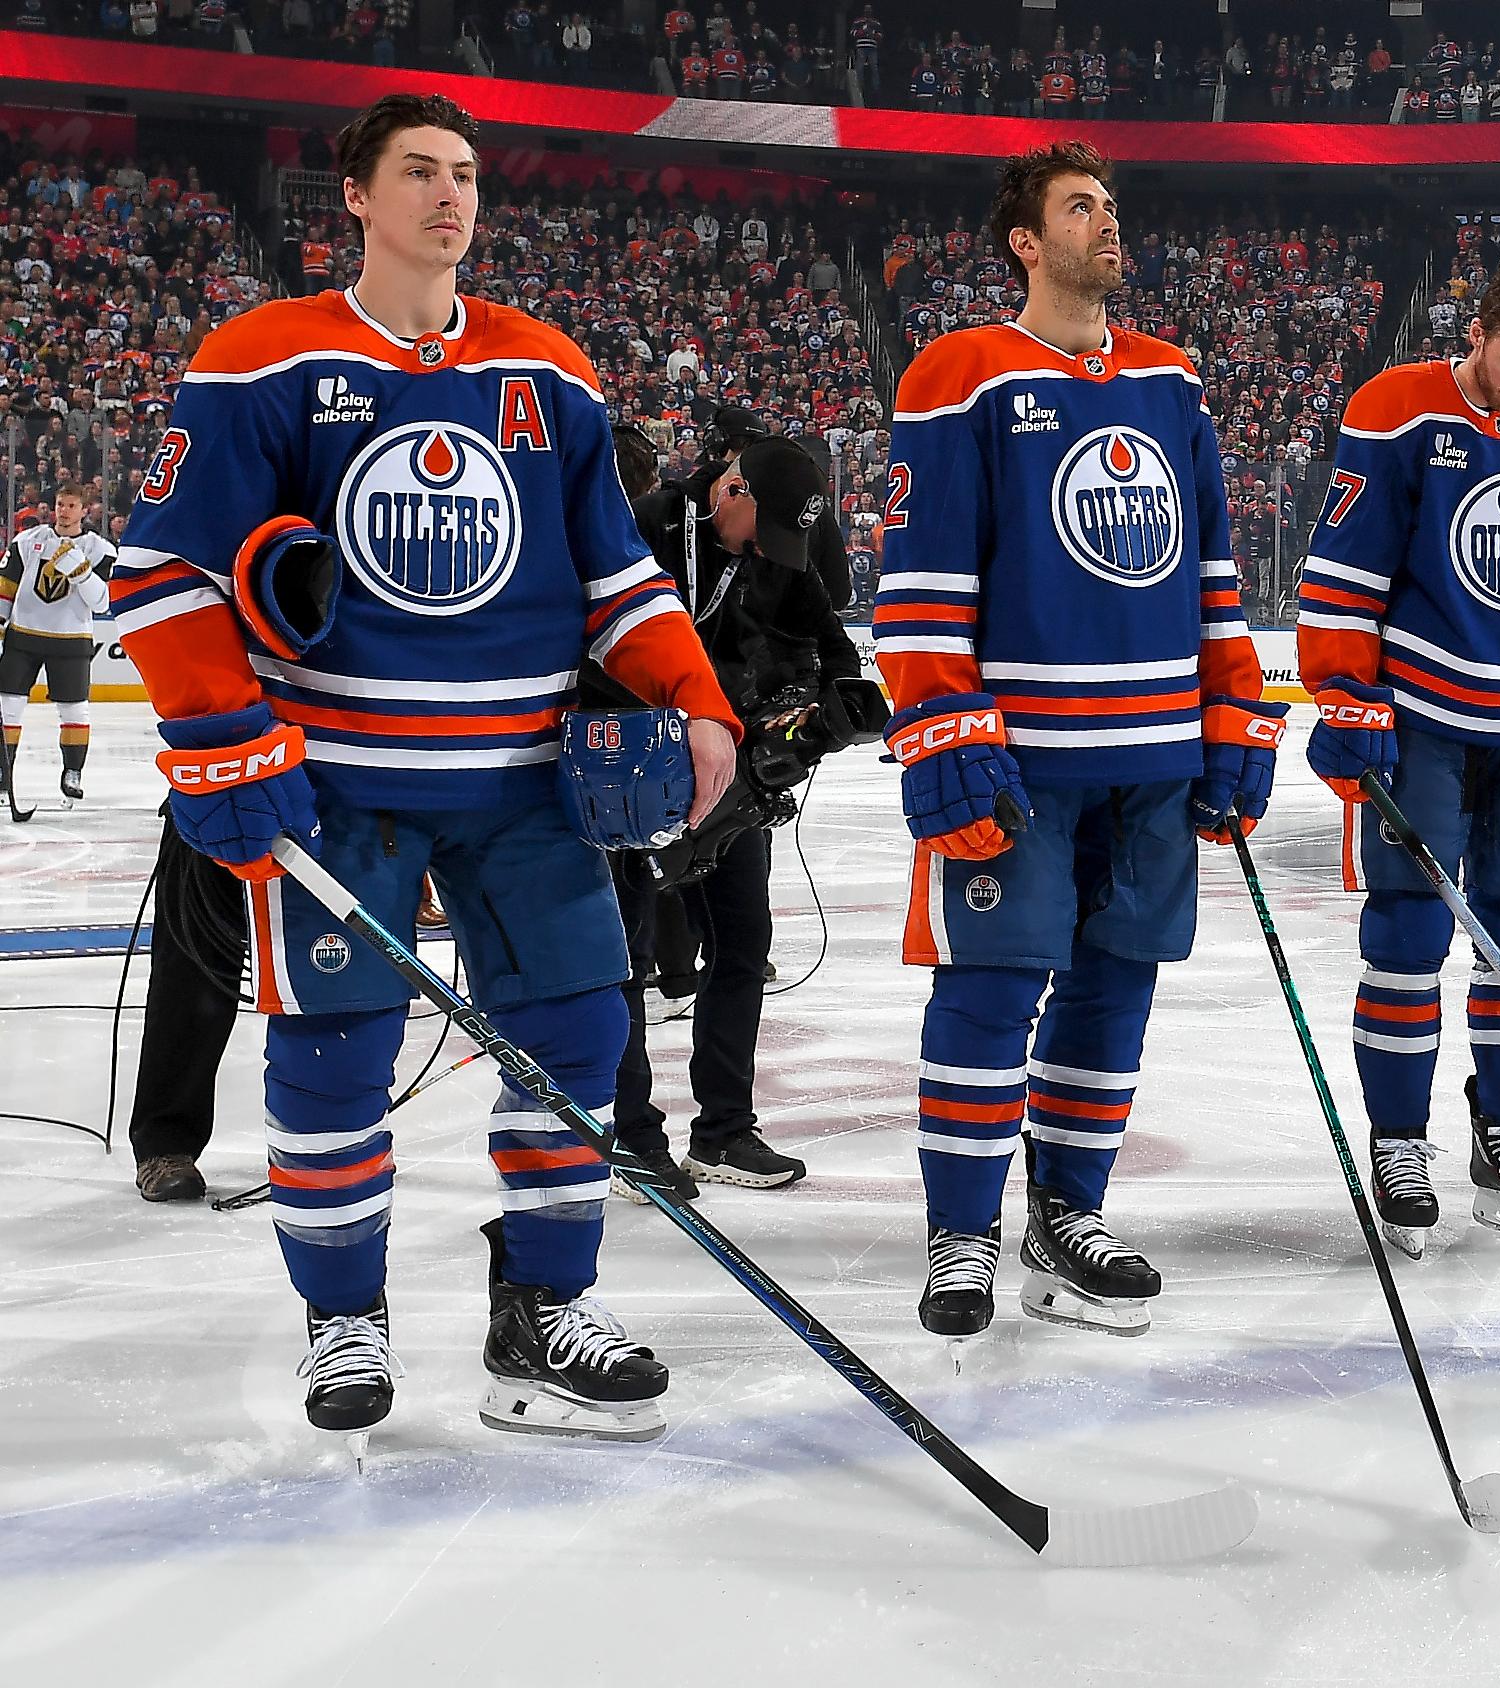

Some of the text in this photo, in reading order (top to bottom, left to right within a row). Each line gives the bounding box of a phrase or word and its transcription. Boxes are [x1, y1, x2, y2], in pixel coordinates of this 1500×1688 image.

[313, 409, 374, 423] alberta
[337, 393, 373, 409] play
[498, 377, 551, 451] A
[1029, 407, 1056, 421] play
[1011, 420, 1060, 433] alberta
[140, 427, 191, 504] 3
[1429, 457, 1468, 469] alberta
[1445, 447, 1468, 460] play
[883, 463, 912, 530] 2
[367, 491, 500, 595] OILERS
[1075, 485, 1172, 572] OILERS
[1320, 704, 1391, 728] CCM
[587, 720, 621, 750] 93
[893, 713, 997, 763] CCM
[171, 741, 287, 784] CCM
[451, 1005, 573, 1114] CCM
